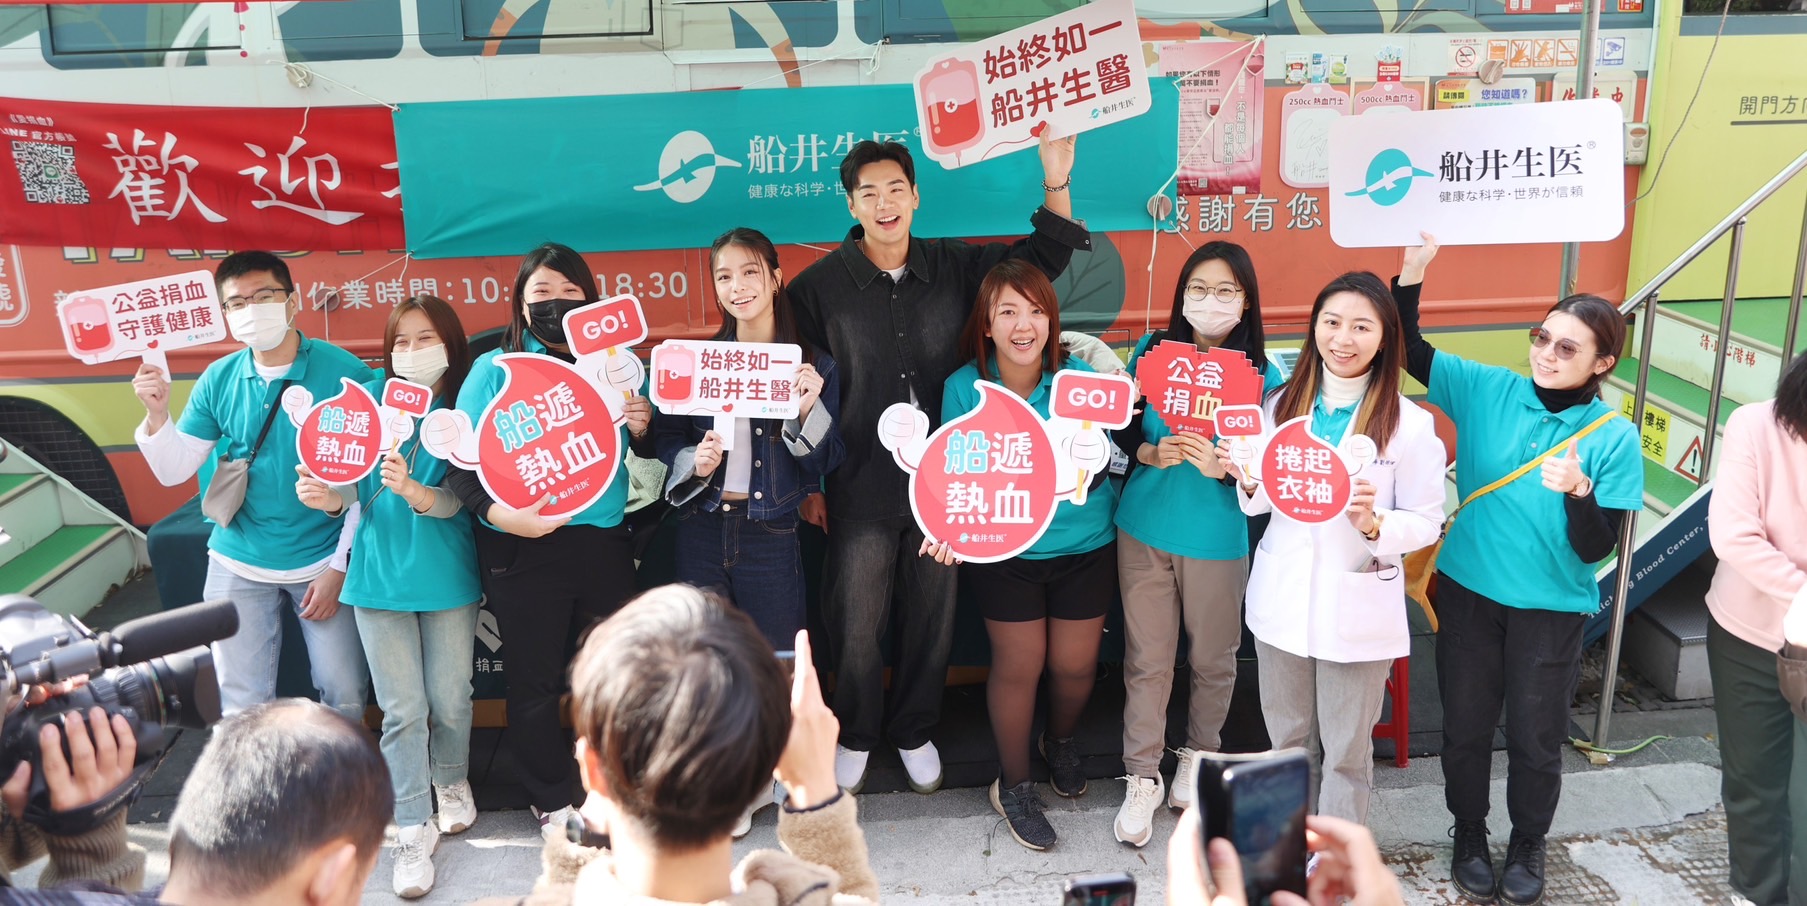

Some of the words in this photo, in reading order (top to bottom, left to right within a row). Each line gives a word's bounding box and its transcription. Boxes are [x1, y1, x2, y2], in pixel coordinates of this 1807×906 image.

[983, 20, 1122, 85] 始終如一
[991, 53, 1131, 128] 船井生醫
[1289, 98, 1312, 106] 250cc
[1361, 95, 1383, 104] 500cc
[1481, 88, 1528, 100] 您知道嗎?
[102, 129, 403, 226] 歡迎
[1439, 185, 1584, 203] 健康な科学・世界が信頼
[112, 279, 208, 314] 公益捐血
[117, 306, 213, 341] 守護健康
[582, 309, 629, 340] GO!
[700, 348, 793, 372] 始終如一
[1167, 356, 1224, 390] 公益
[393, 388, 421, 406] GO!
[699, 376, 792, 402] 船井生醫
[1067, 387, 1117, 411] GO!
[1163, 386, 1224, 421] 捐血
[317, 405, 371, 437] 船遞
[492, 381, 585, 454] 船遞
[1223, 414, 1255, 429] GO!
[1623, 401, 1667, 433] 上樓梯
[315, 436, 366, 467] 熱血
[514, 430, 607, 496] 熱血
[943, 428, 1034, 475] 船遞
[1275, 443, 1332, 475] 捲起
[944, 480, 1035, 525] 熱血
[1277, 475, 1333, 505] 衣袖
[1635, 554, 1665, 581] Blood
[1666, 525, 1704, 556] Center,
